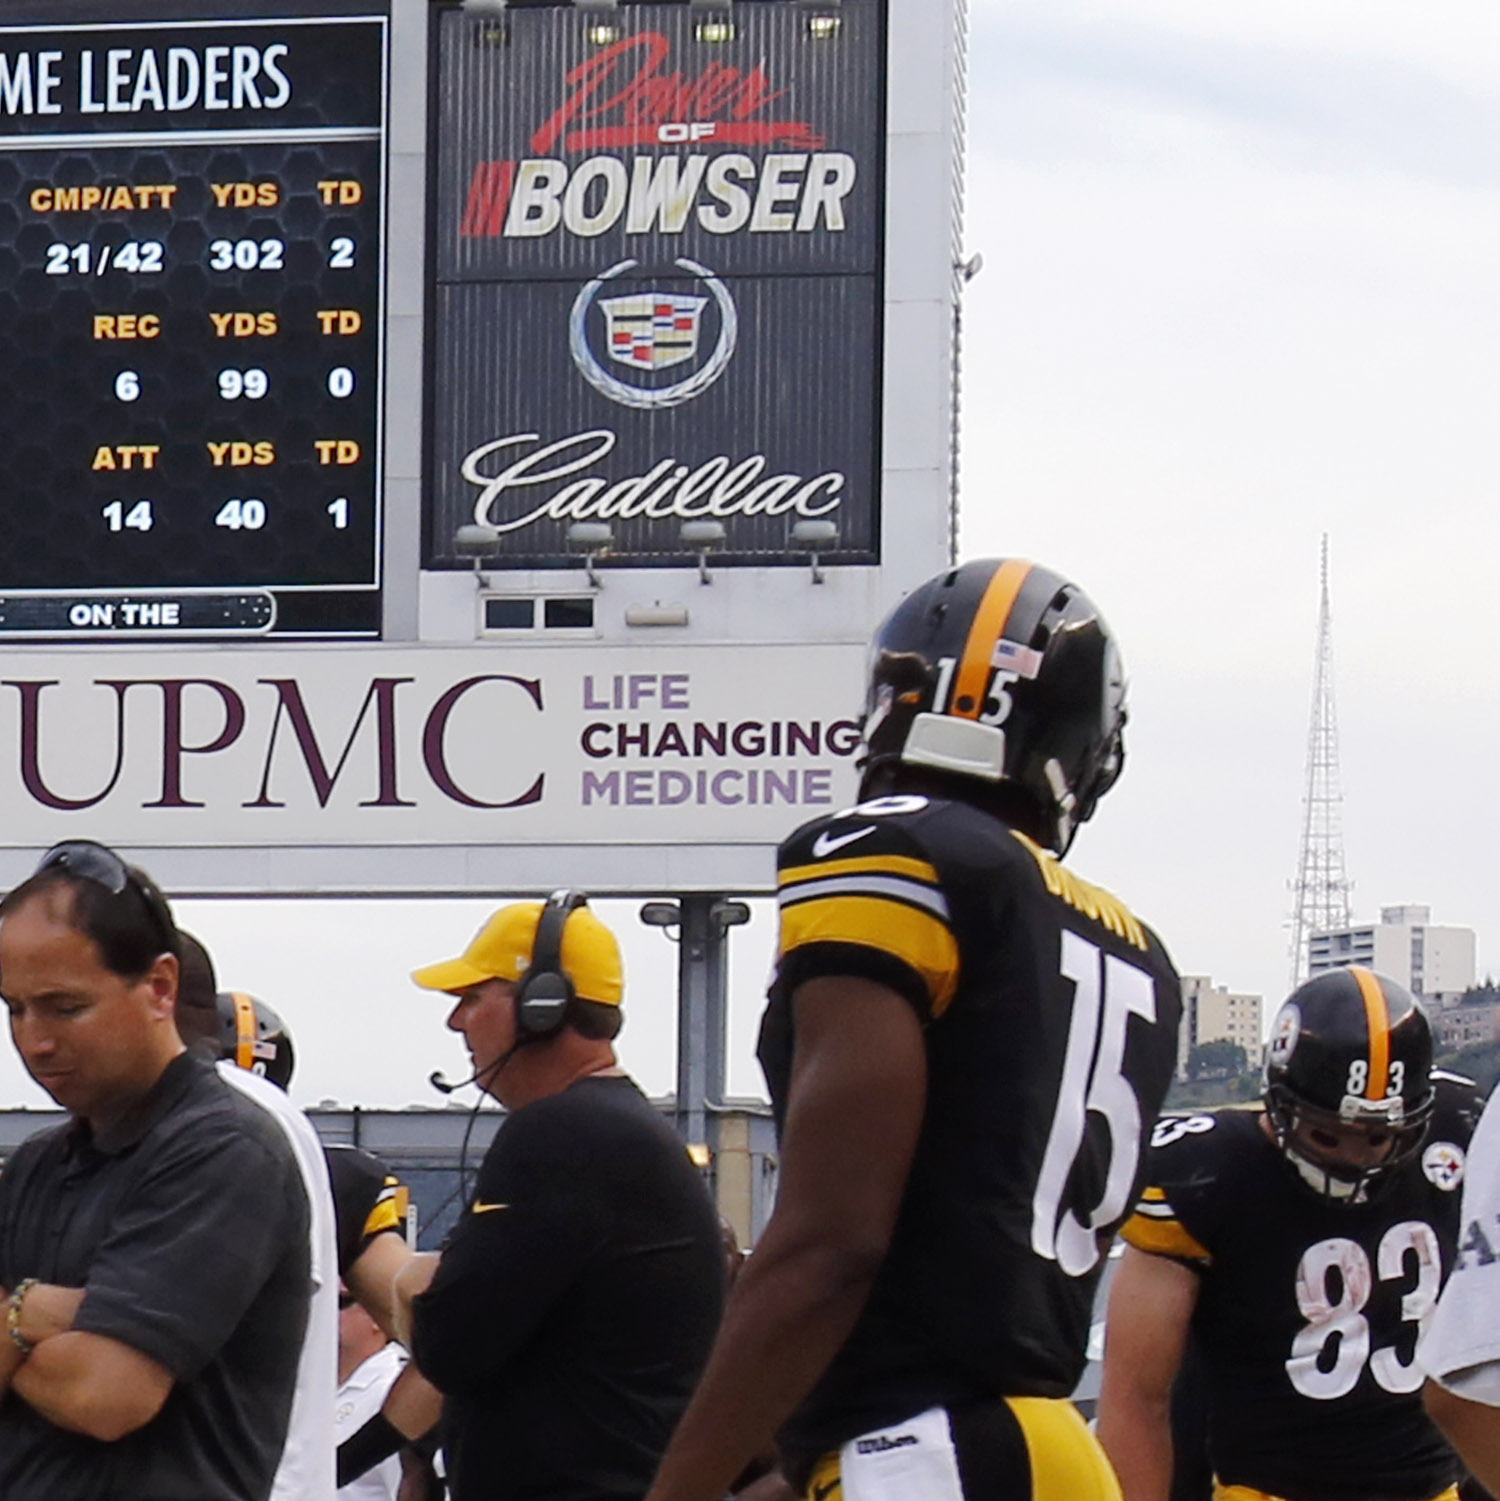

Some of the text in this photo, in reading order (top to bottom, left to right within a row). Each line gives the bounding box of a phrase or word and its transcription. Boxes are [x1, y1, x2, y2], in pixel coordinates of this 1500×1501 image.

[79, 45, 291, 112] LEADERS
[658, 122, 715, 143] OF
[30, 186, 177, 214] CMP/ATT
[212, 183, 279, 210] YDS
[319, 180, 362, 207] TD
[504, 154, 856, 238] BOWSER
[46, 243, 165, 277] 21/42
[210, 239, 284, 272] 302
[329, 239, 354, 269] 2
[93, 314, 161, 341] REC
[210, 311, 278, 339] YDS
[318, 310, 362, 336] TD
[115, 371, 140, 401] 6
[218, 369, 268, 400] 99
[328, 369, 354, 399] 0
[93, 444, 161, 471] ATT
[208, 442, 275, 469] YDS
[316, 440, 360, 466] TD
[461, 429, 845, 533] Cadillac
[102, 501, 153, 533] 14
[216, 499, 265, 530] 40
[328, 498, 349, 529] 1
[69, 601, 114, 628] ON
[120, 600, 181, 627] THE
[582, 675, 690, 711] LIFE
[1, 674, 546, 811] UPMC
[580, 721, 862, 757] CHANGING
[581, 769, 833, 806] MEDICINE
[1032, 927, 1158, 1279] 15
[1285, 1220, 1443, 1400] 83
